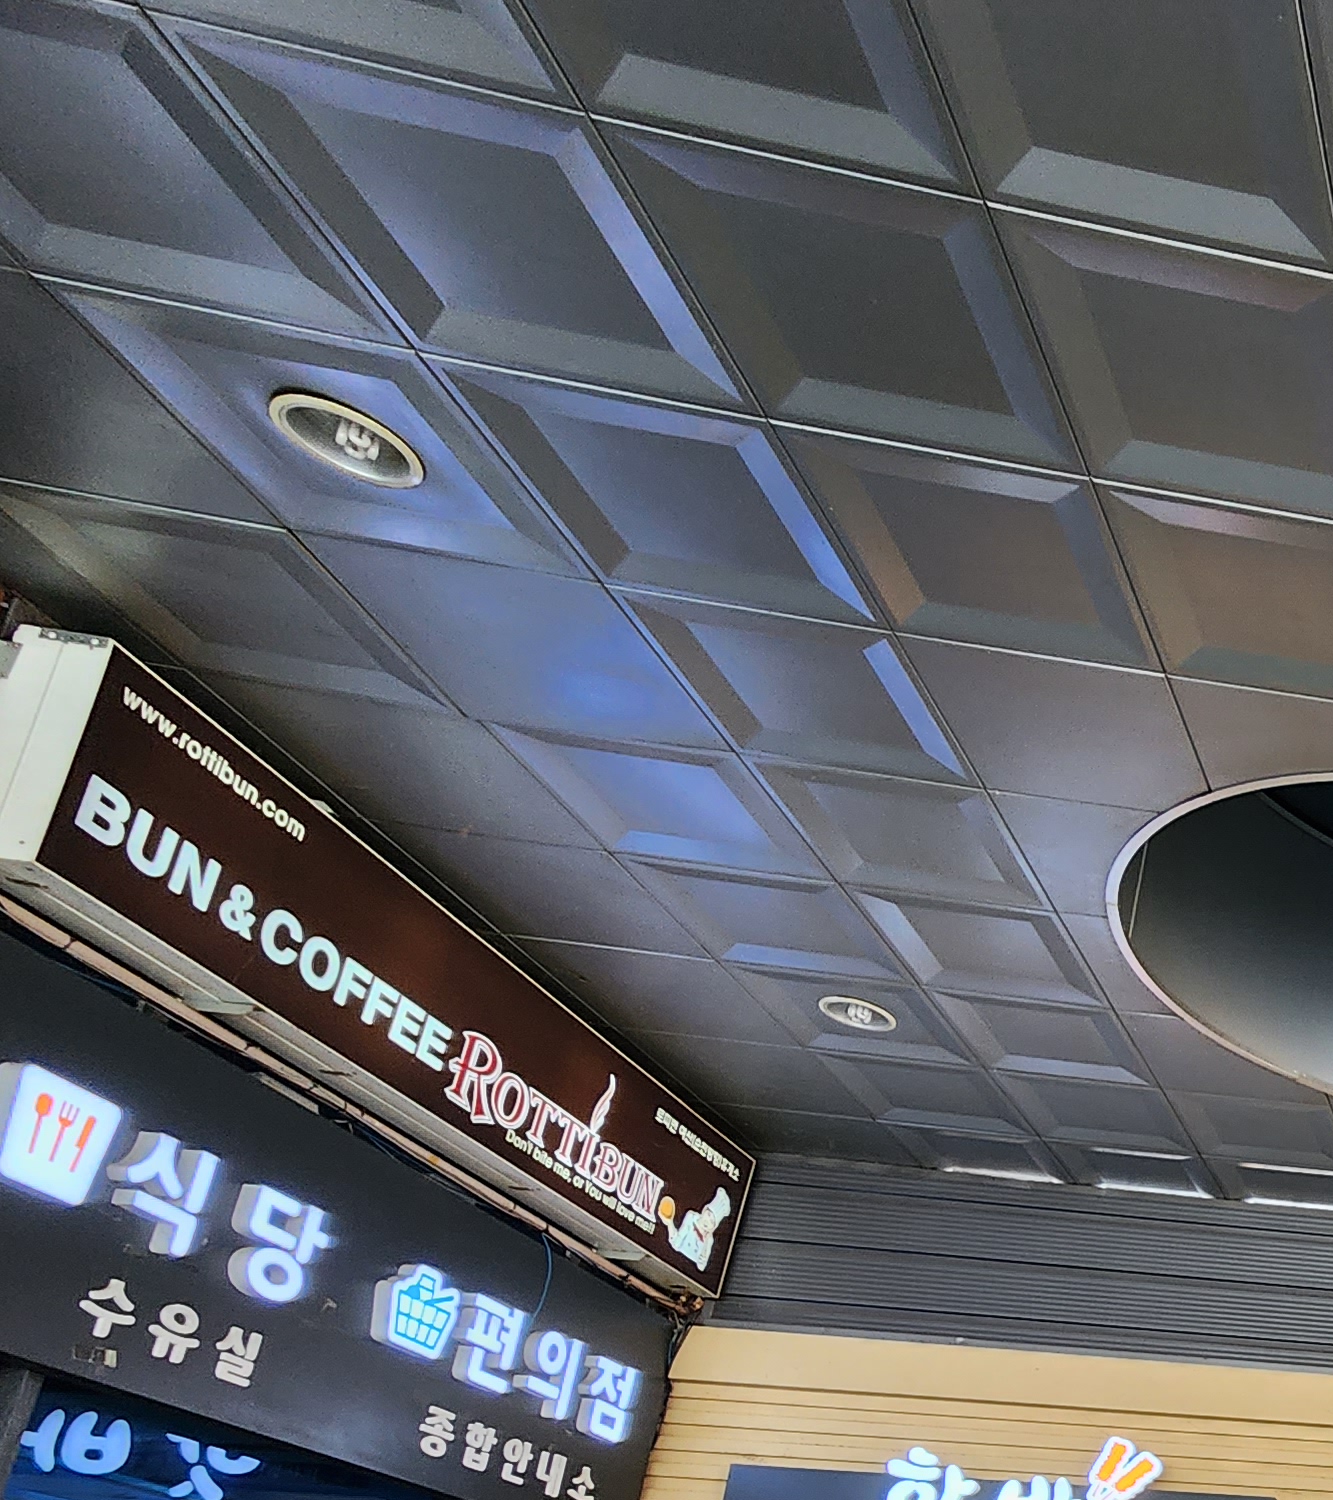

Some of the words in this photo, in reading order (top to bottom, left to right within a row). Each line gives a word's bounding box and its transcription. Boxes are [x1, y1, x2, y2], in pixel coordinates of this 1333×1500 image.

[122, 686, 307, 842] www.rottibun.com
[74, 773, 222, 913] BUN
[218, 883, 257, 941] &
[260, 908, 453, 1073] COFFEE
[106, 1130, 332, 1302] 식당
[505, 1129, 533, 1155] Don't
[532, 1147, 554, 1169] bite
[79, 1278, 263, 1388] 수유실
[451, 1292, 643, 1444] 편의점
